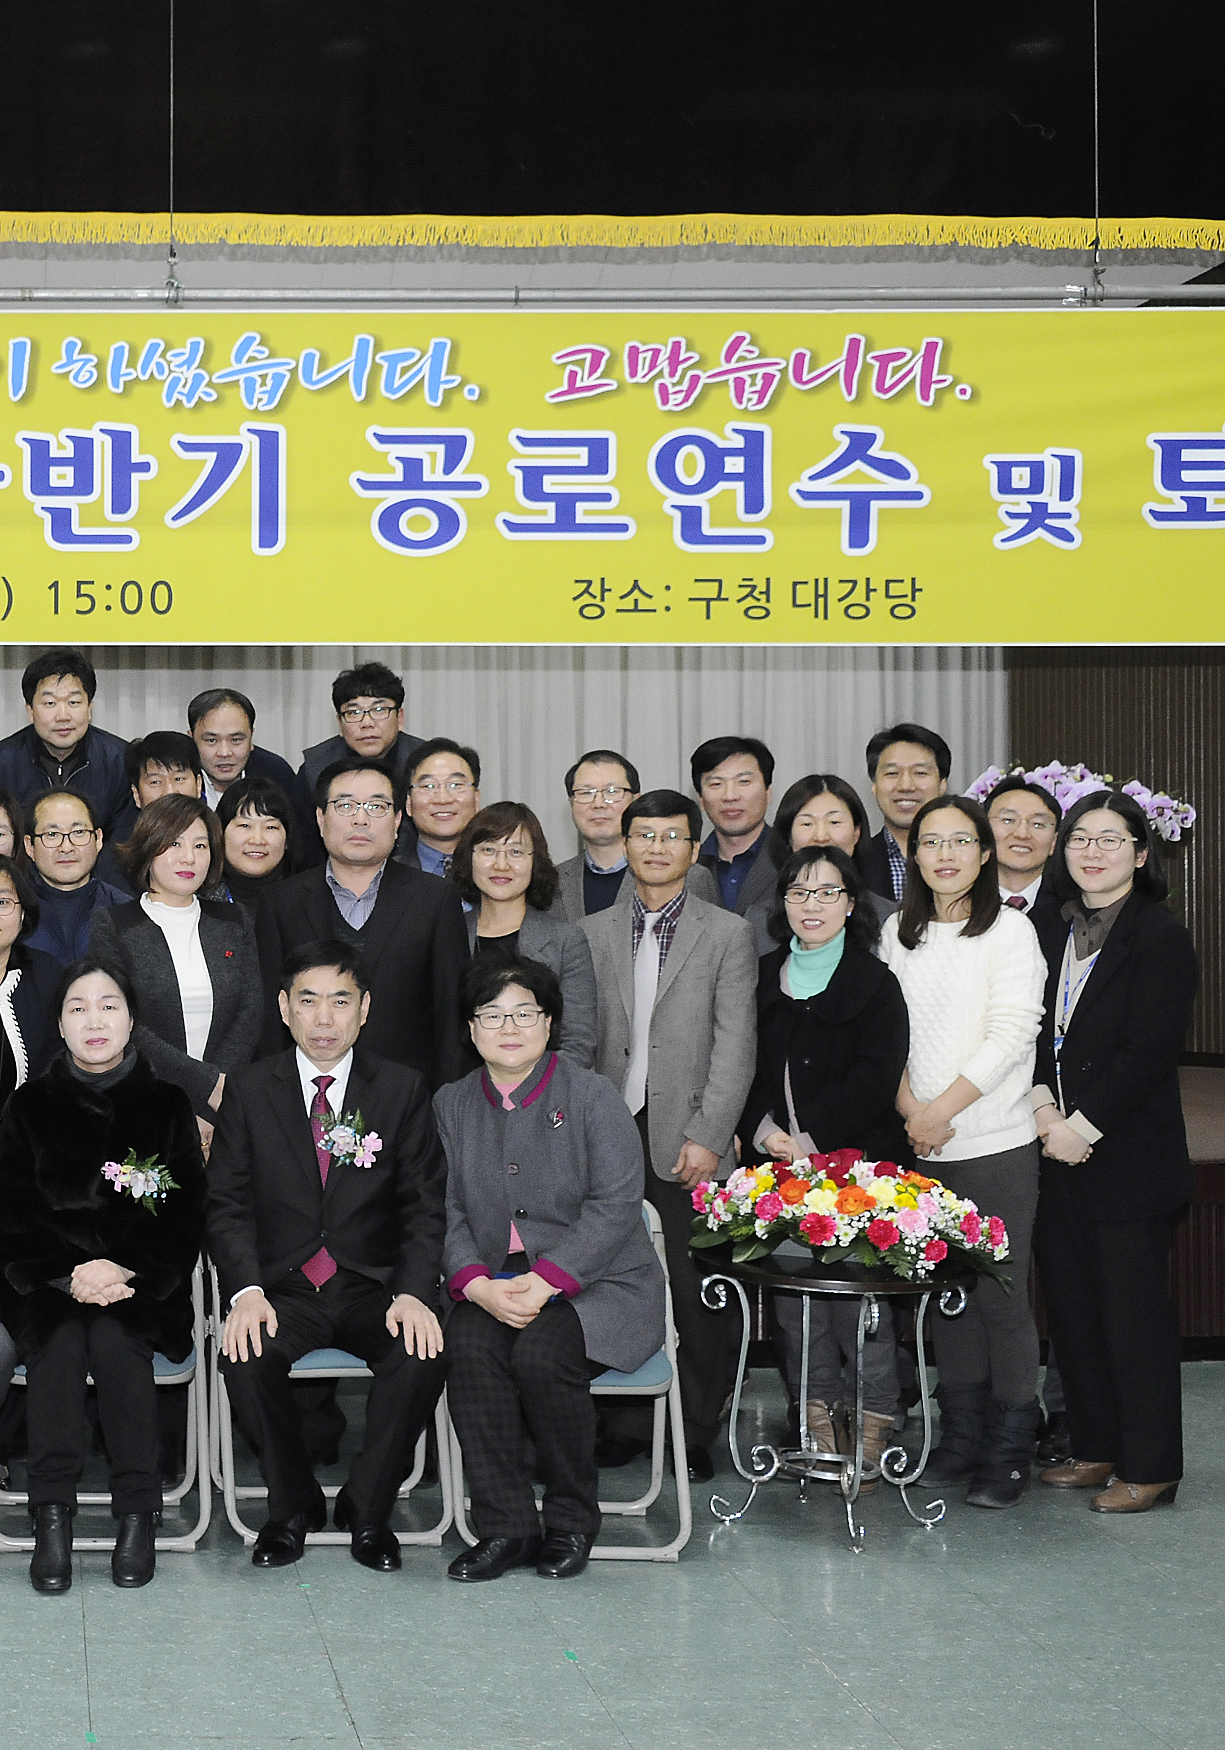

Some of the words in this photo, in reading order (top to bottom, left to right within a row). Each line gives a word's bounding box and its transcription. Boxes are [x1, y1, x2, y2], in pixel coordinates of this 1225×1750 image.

[51, 331, 480, 411] 하셨습니다.
[544, 331, 972, 411] 고맙습니다.
[349, 421, 932, 557] 공로연수
[982, 447, 1083, 550] 및
[47, 580, 173, 615] 15:00
[572, 577, 671, 620] 장소:
[688, 577, 771, 620] 구청
[791, 577, 923, 621] 대강당
